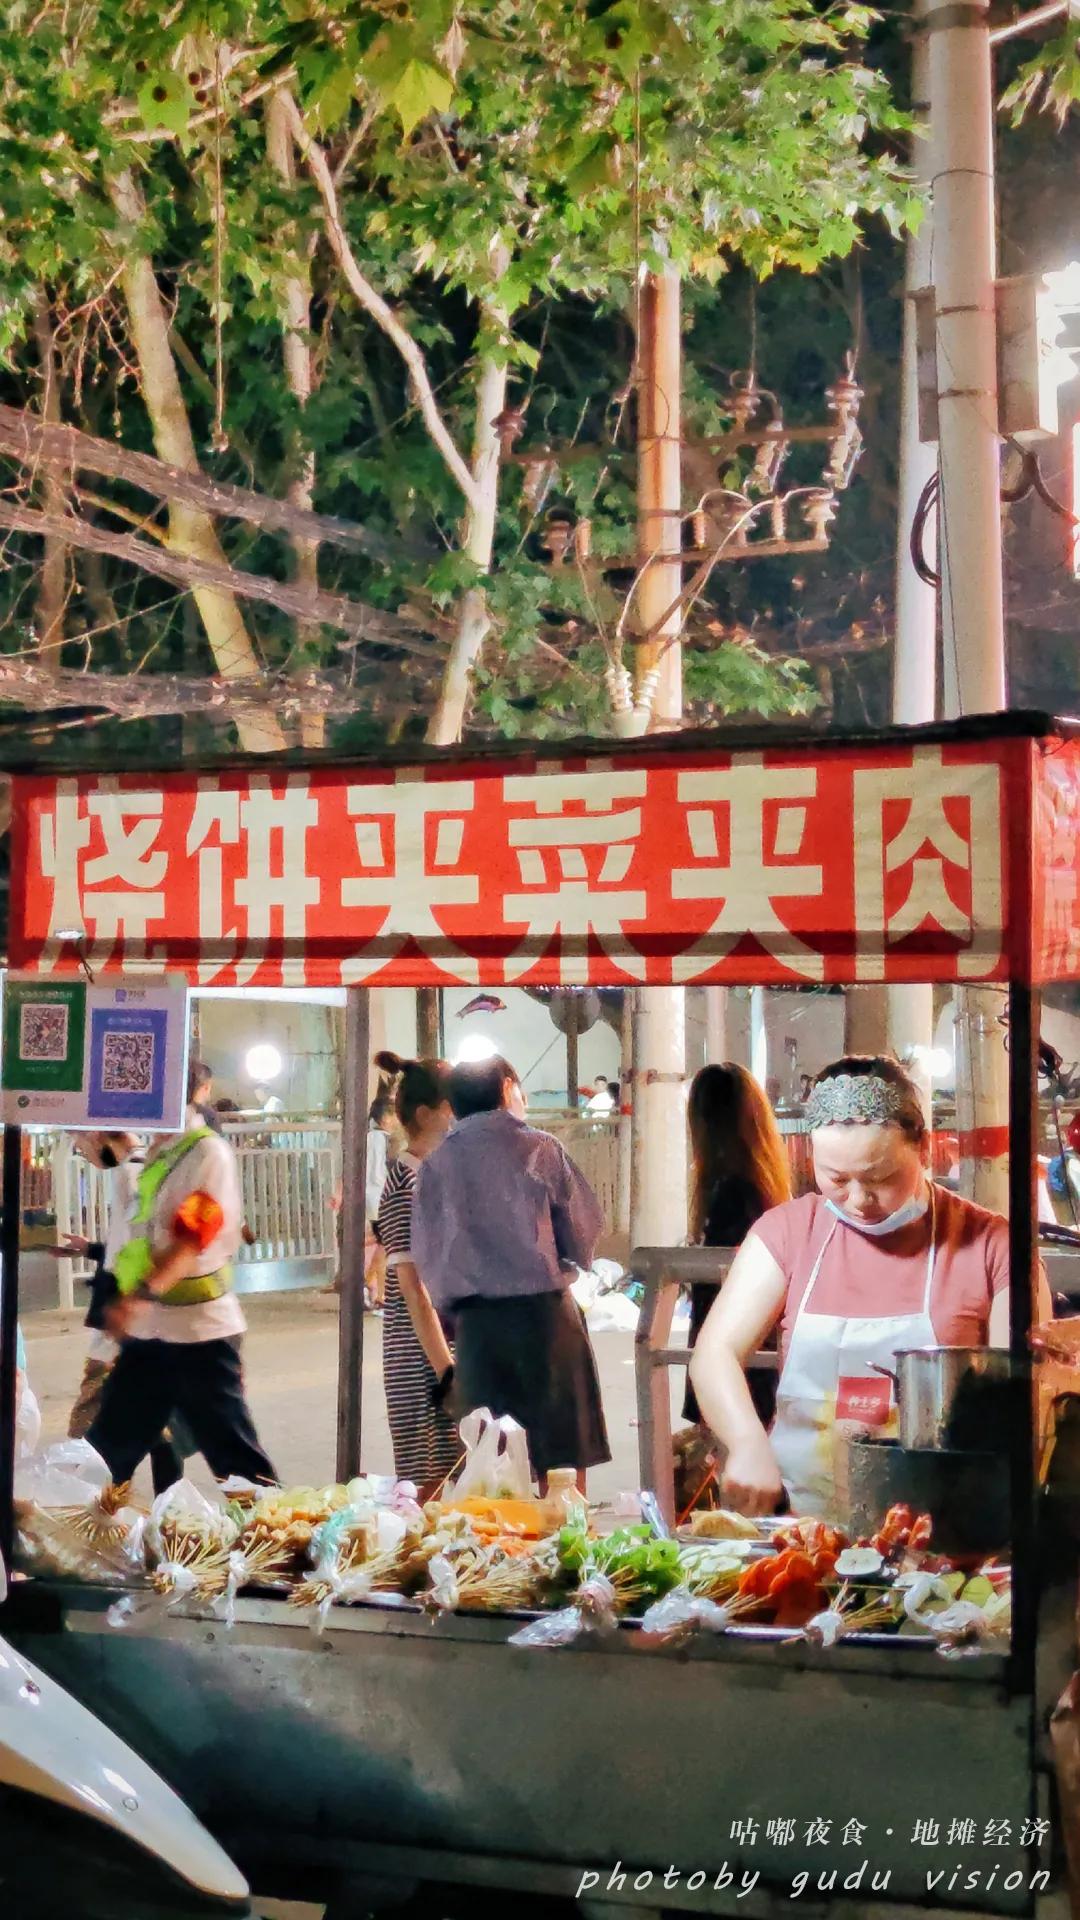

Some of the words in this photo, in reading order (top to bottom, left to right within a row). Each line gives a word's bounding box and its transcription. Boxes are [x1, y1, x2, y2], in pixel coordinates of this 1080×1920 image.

[38, 745, 1006, 986] 烧饼夹菜夹肉
